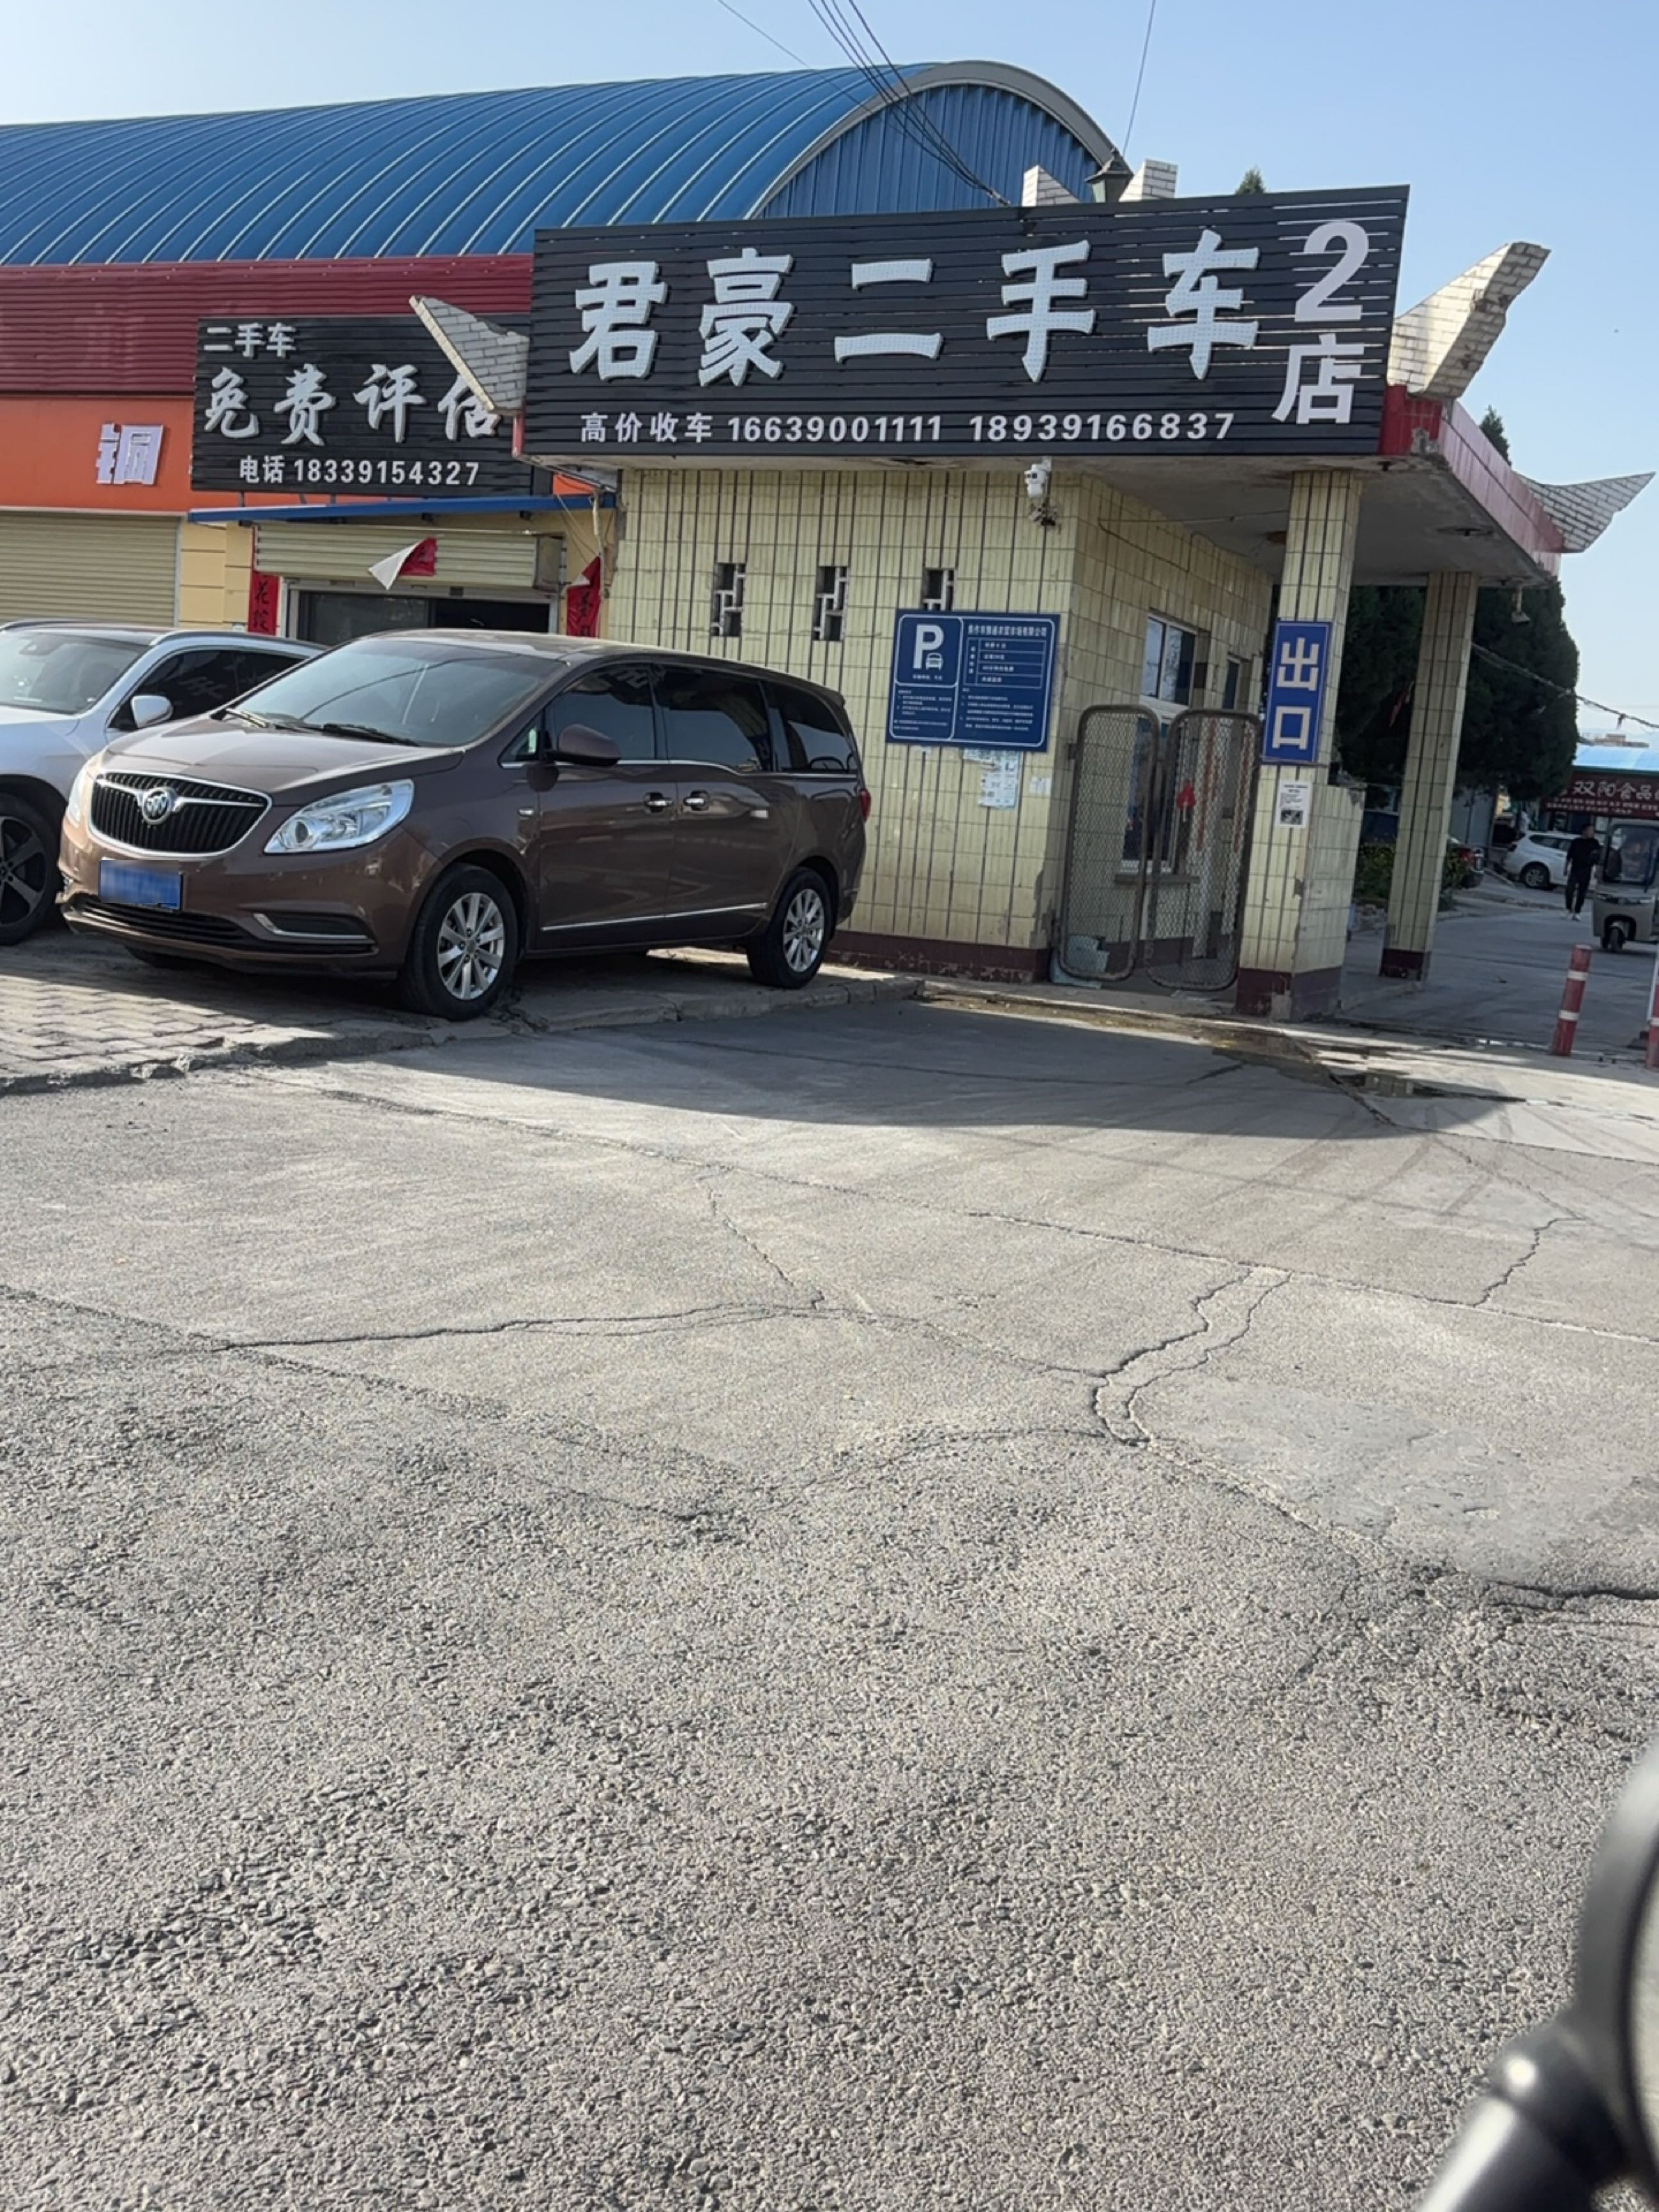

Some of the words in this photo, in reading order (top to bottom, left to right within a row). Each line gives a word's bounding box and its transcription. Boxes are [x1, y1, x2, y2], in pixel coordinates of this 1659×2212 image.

[569, 228, 1260, 387] 君豪二手车
[204, 322, 296, 357] 二手车
[204, 363, 501, 446] 免费评估
[581, 412, 713, 444] 高价收车
[727, 414, 942, 443] 16639001111
[968, 412, 1235, 442] 18939166837
[239, 454, 285, 485] 电话
[293, 458, 481, 486] 18339154327
[913, 623, 945, 670] P
[1271, 637, 1320, 751] 出口
